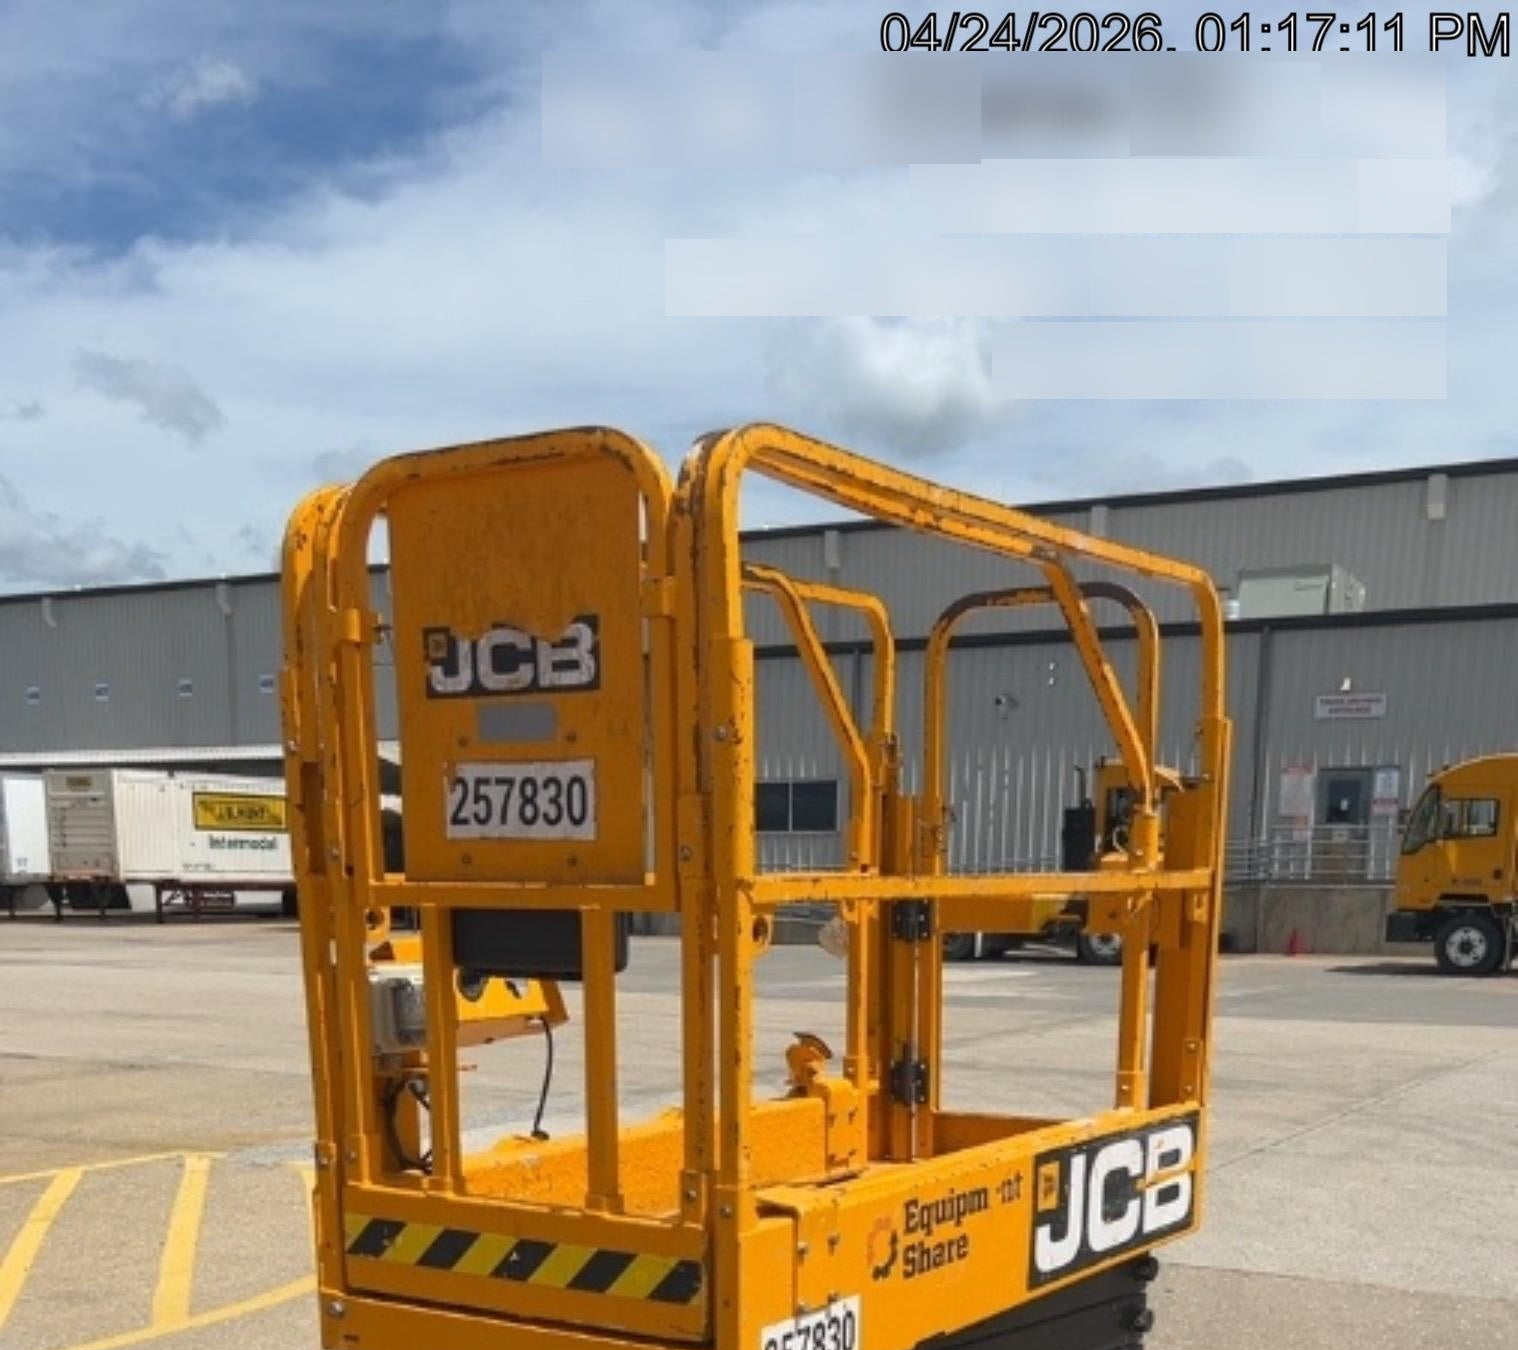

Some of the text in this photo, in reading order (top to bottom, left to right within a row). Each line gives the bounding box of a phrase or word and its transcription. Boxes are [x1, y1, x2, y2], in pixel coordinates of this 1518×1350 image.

[429, 621, 597, 695] JCB
[450, 774, 588, 827] 257830
[208, 834, 278, 852] Intermodal
[903, 1170, 1024, 1236] Equipmnt
[1034, 1124, 1195, 1274] JCB
[902, 1232, 969, 1279] Share
